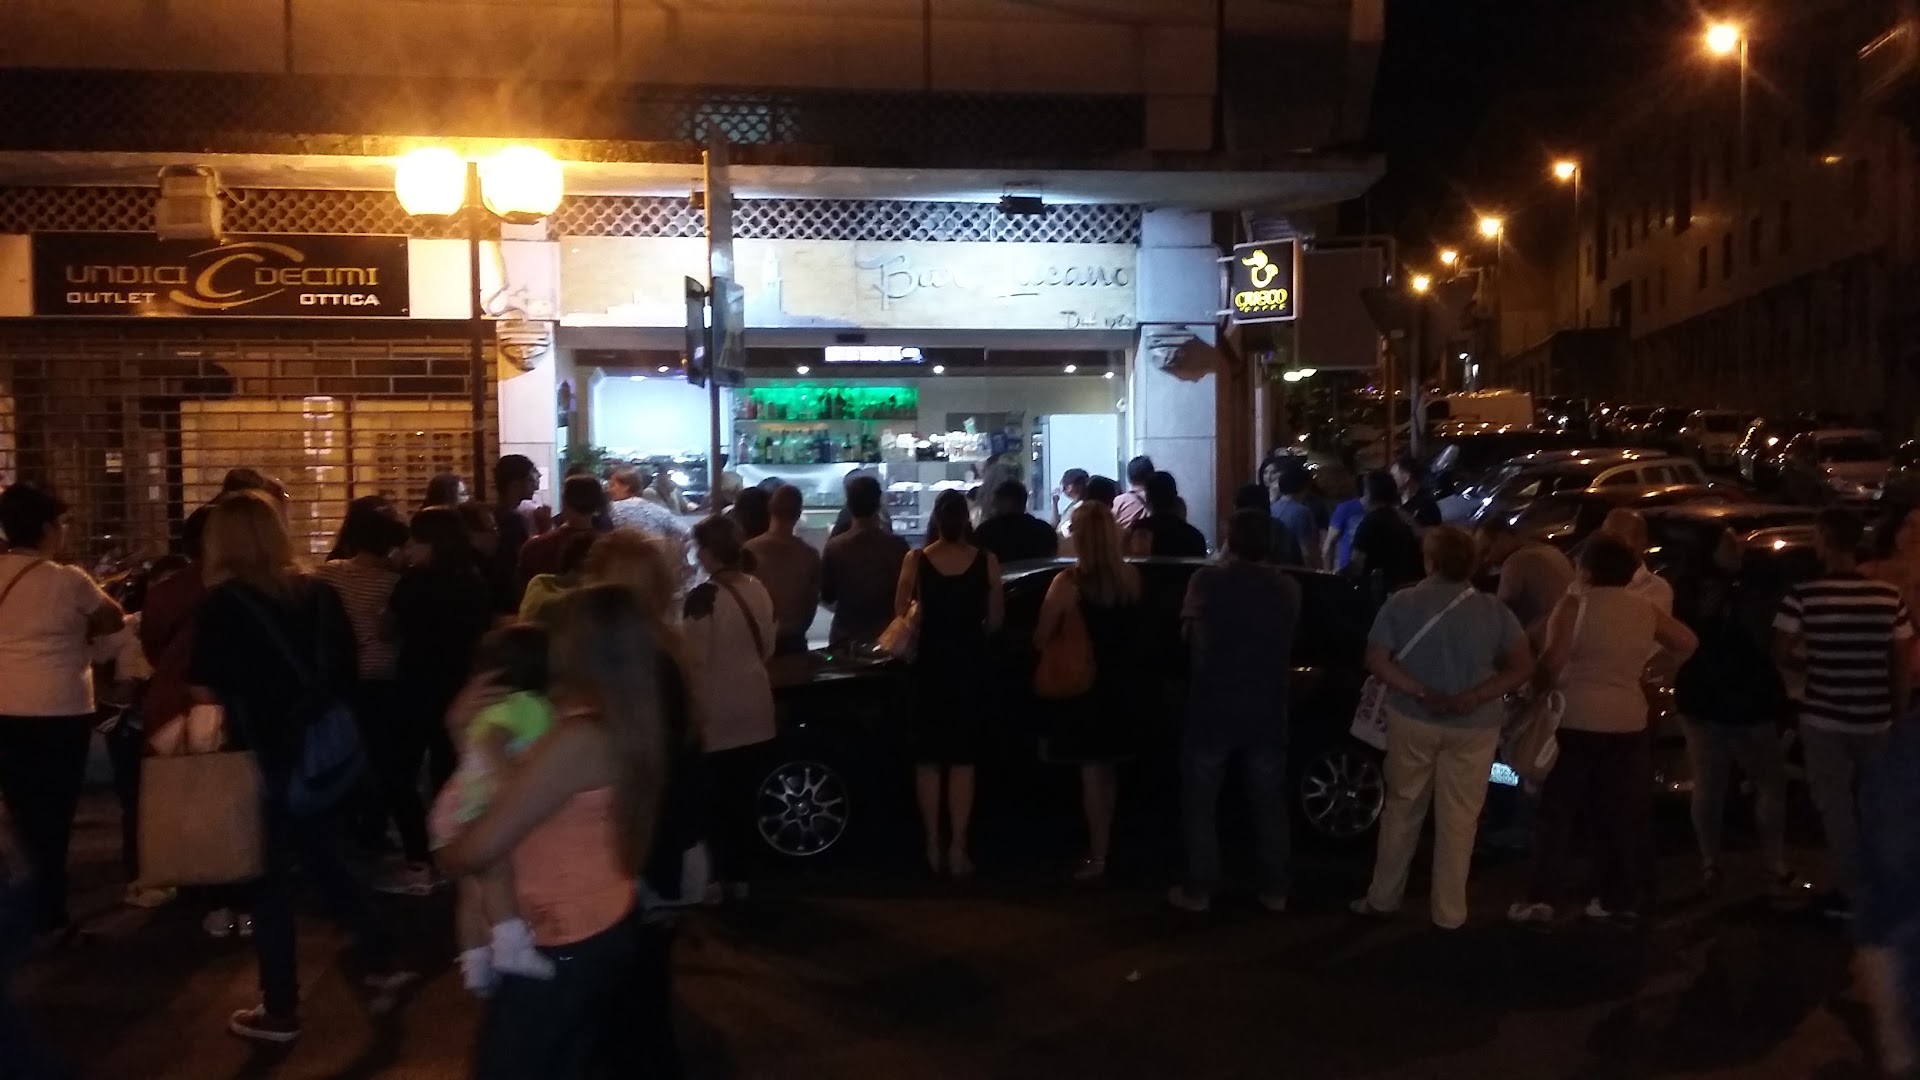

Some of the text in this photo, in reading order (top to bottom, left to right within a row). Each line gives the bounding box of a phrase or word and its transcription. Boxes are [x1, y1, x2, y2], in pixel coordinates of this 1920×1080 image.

[65, 265, 380, 286] UNDICI DECIMI
[991, 262, 1131, 299] ucano
[66, 291, 156, 304] OUTLET
[299, 293, 381, 306] OTTICA
[302, 395, 336, 555] OUTLE
